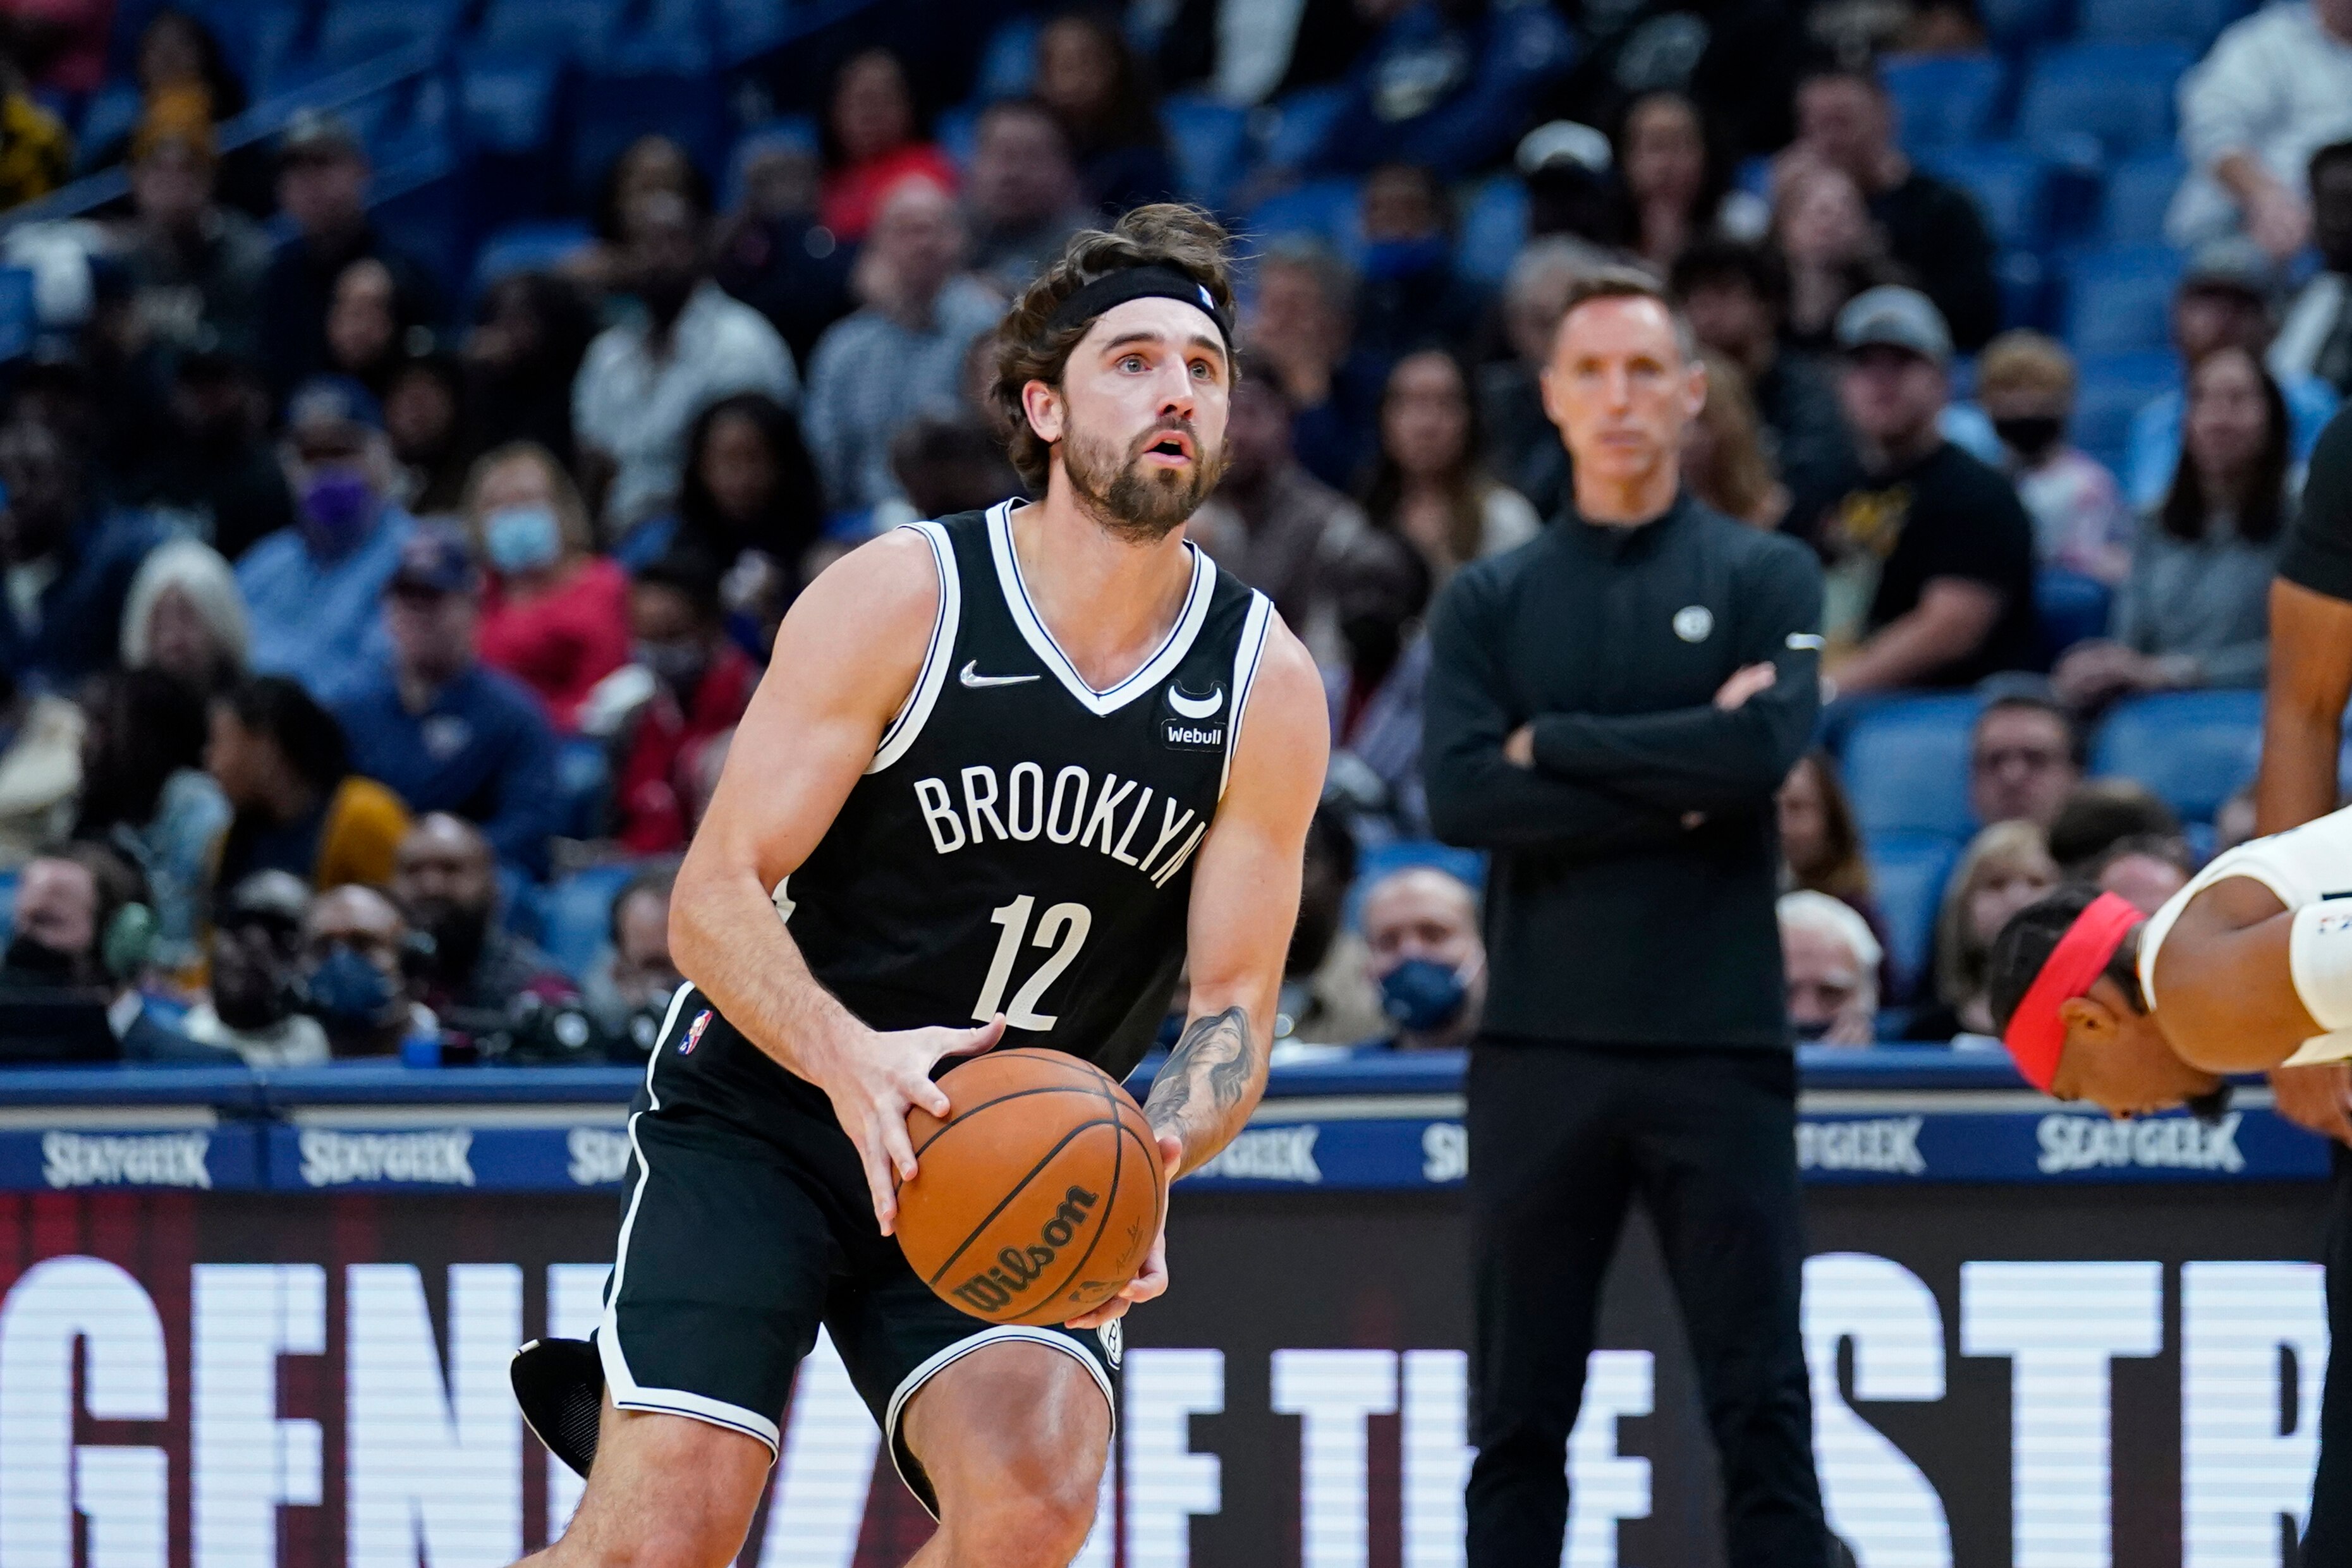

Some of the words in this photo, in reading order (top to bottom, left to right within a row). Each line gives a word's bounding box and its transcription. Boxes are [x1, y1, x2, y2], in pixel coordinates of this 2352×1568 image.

[1167, 726, 1222, 744] Webull
[971, 894, 1092, 1031] 12
[42, 1129, 213, 1190] SEATGEEK
[298, 1126, 476, 1188] SEATGEEK
[951, 1184, 1100, 1313] Wilson
